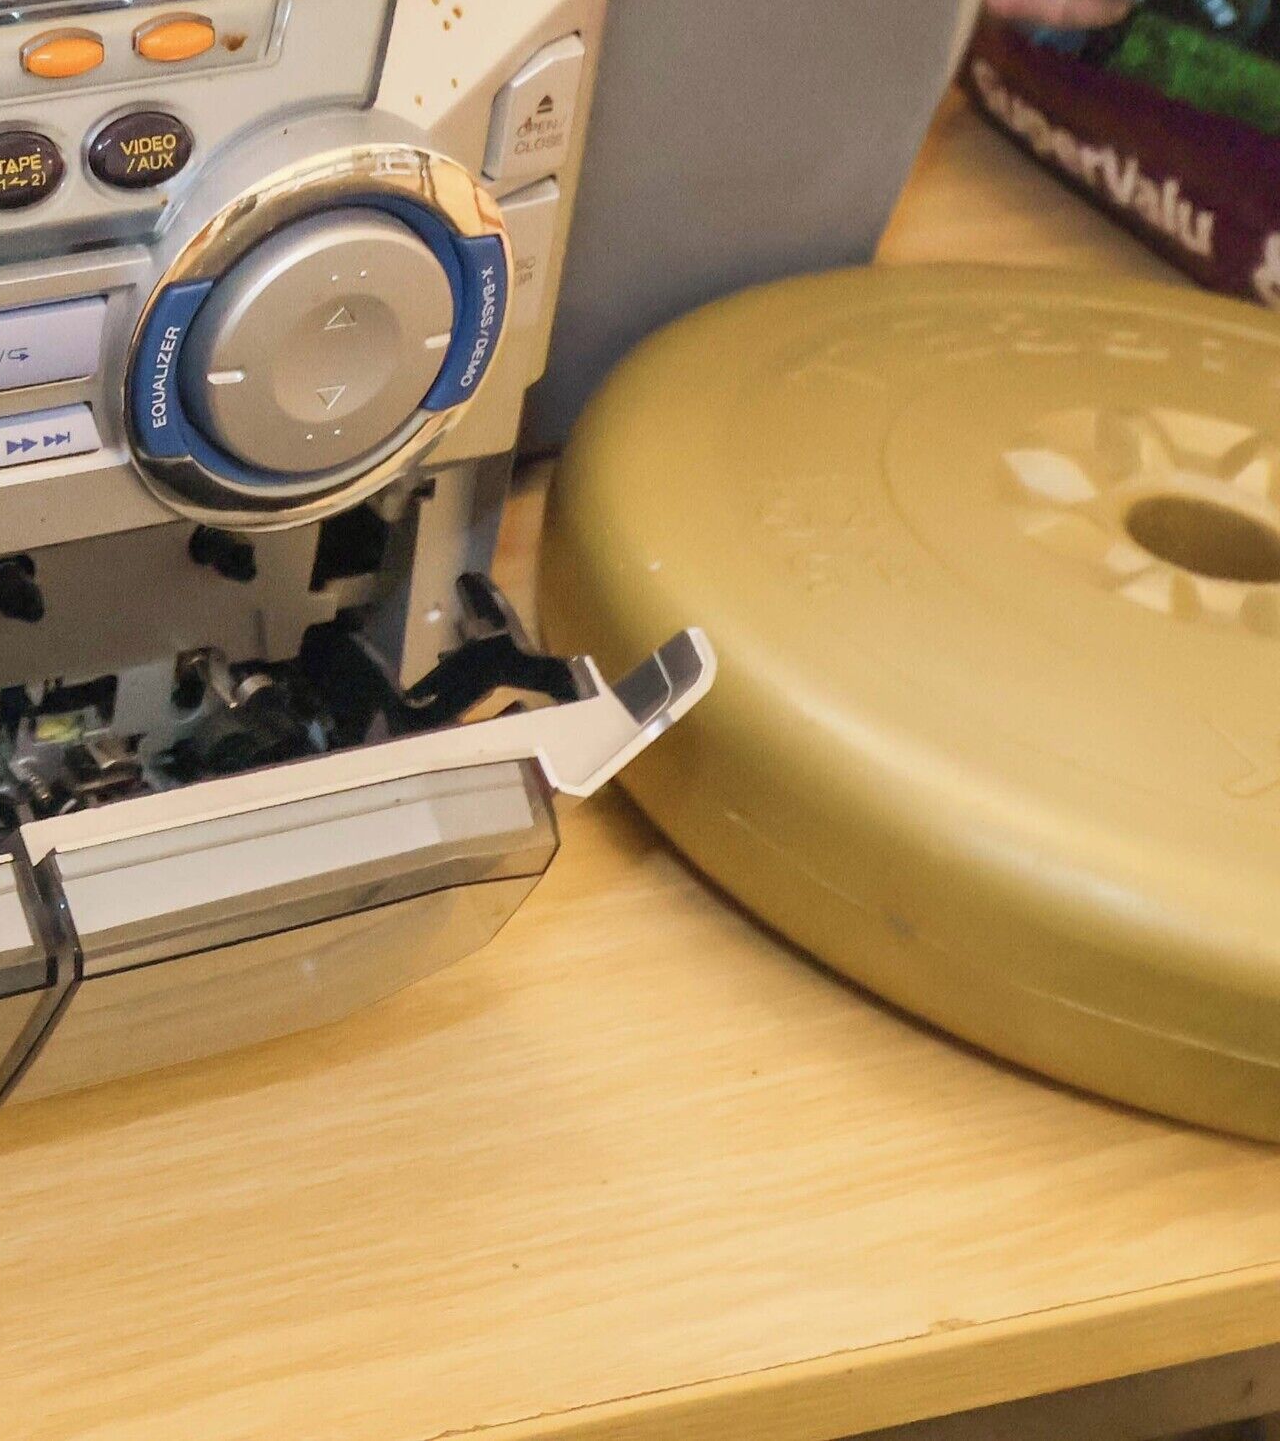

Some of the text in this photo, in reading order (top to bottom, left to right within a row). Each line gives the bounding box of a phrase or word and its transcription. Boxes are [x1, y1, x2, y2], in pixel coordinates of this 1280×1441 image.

[120, 134, 177, 156] VIDEO
[126, 153, 174, 174] /AUX
[151, 326, 181, 429] EQUALIZER
